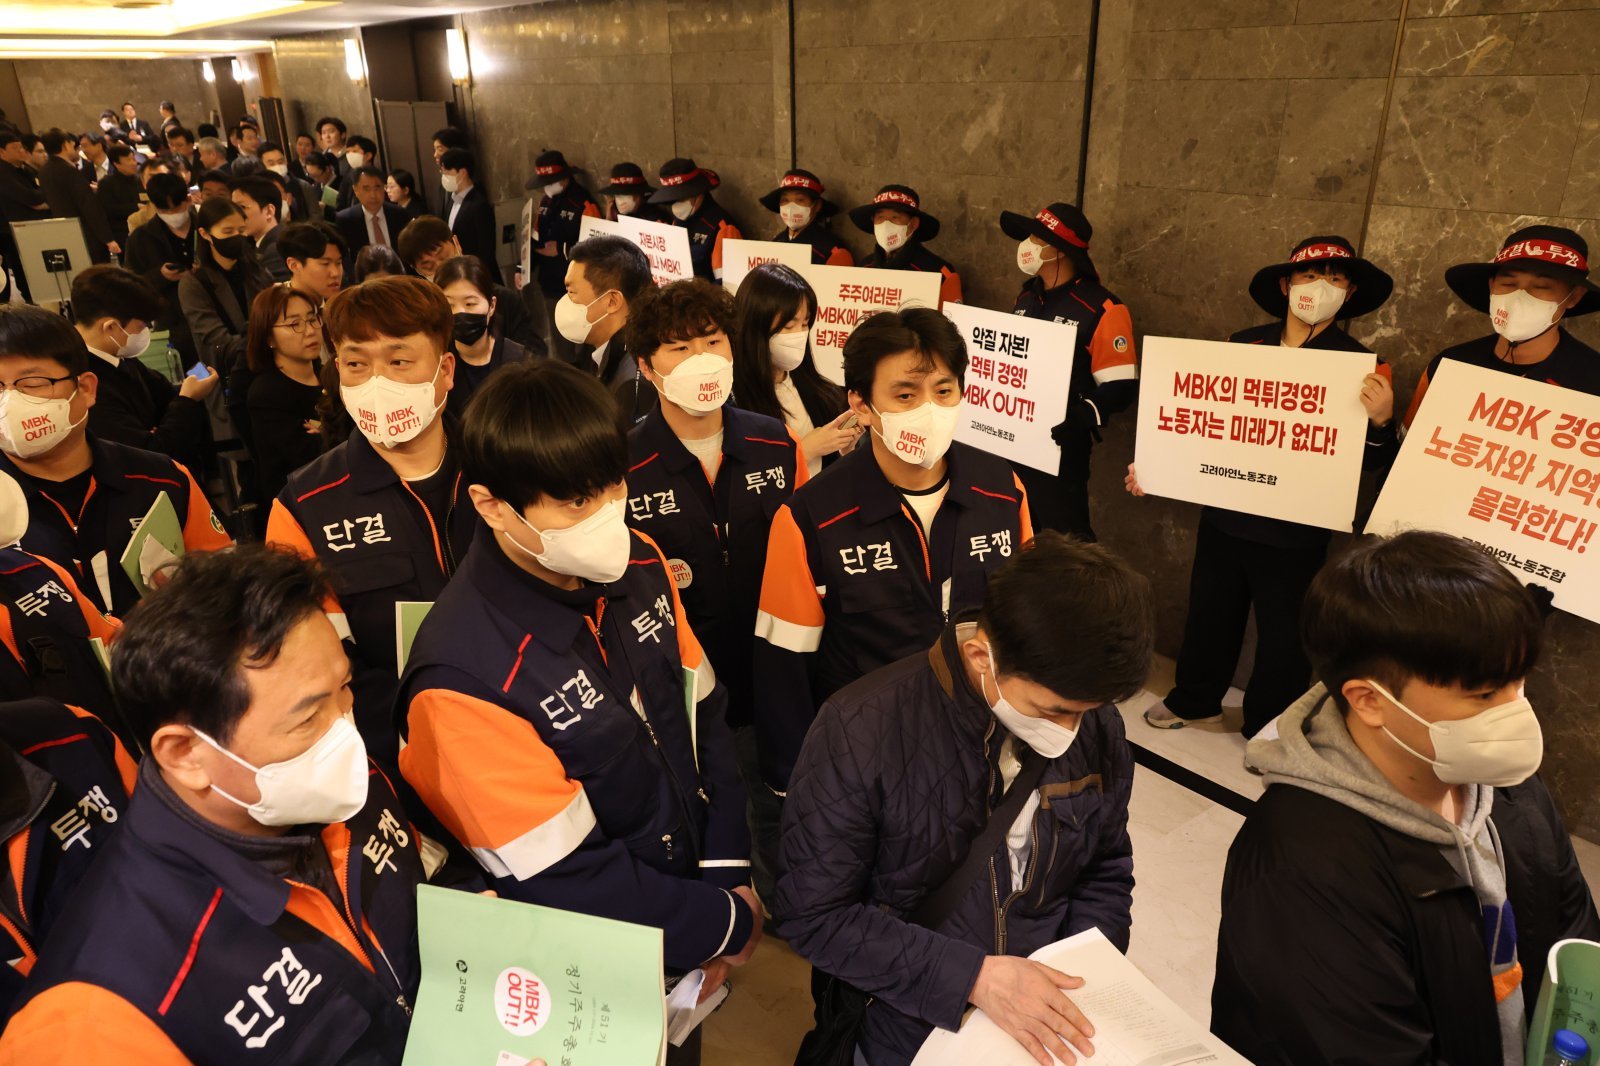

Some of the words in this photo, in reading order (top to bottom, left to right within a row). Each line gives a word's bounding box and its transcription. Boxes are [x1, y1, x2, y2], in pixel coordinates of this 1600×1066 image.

[1041, 212, 1060, 231] 투쟁
[639, 232, 667, 252] 자본시장
[1545, 244, 1580, 268] 투쟁
[660, 256, 682, 276] MBK!
[839, 284, 902, 307] 주주여러분!
[1299, 295, 1314, 304] MBK
[816, 306, 859, 326] MBK에
[972, 326, 997, 352] 악질
[998, 332, 1030, 360] 자본!
[699, 380, 720, 393] MBK
[971, 355, 995, 382] 먹튀
[998, 362, 1028, 390] 경영!
[697, 390, 724, 402] OUT!!
[962, 383, 991, 410] MBK
[992, 391, 1036, 423] OUT!!
[1173, 371, 1238, 404] MBK의
[1243, 377, 1327, 415] 먹튀경영!
[21, 413, 52, 431] MBK
[385, 405, 415, 424] MBK
[387, 416, 422, 437] OUT!!
[970, 420, 1015, 442] 고려아연노동조합
[1157, 405, 1225, 441] 노동자는
[1229, 415, 1286, 449] 미래가
[1291, 422, 1338, 457] 없다!
[1468, 391, 1552, 441] MBK
[24, 423, 57, 442] OUT!!
[899, 430, 928, 448] MBK
[895, 441, 926, 460] OUT!!
[745, 466, 786, 494] 투쟁
[1199, 463, 1278, 486] 고려아연노동조합
[1423, 425, 1538, 486] 노동자와
[1535, 459, 1600, 511] 지역
[628, 489, 680, 521] 단결
[1467, 485, 1599, 554] 몰락한다!
[322, 512, 392, 552] 단결
[969, 529, 1012, 562] 투쟁
[839, 541, 898, 575] 단결
[1462, 536, 1567, 584] 아연노동조합
[673, 572, 692, 582] UT!!
[15, 580, 73, 617] 투쟁
[631, 594, 675, 643] 투쟁
[540, 669, 604, 731] 단결
[50, 785, 118, 851] 투쟁
[362, 808, 409, 875] 투쟁
[224, 947, 322, 1049] 단결
[455, 977, 467, 1013] 고려아연
[504, 972, 522, 1028] OUT!!
[523, 979, 540, 1027] MBK
